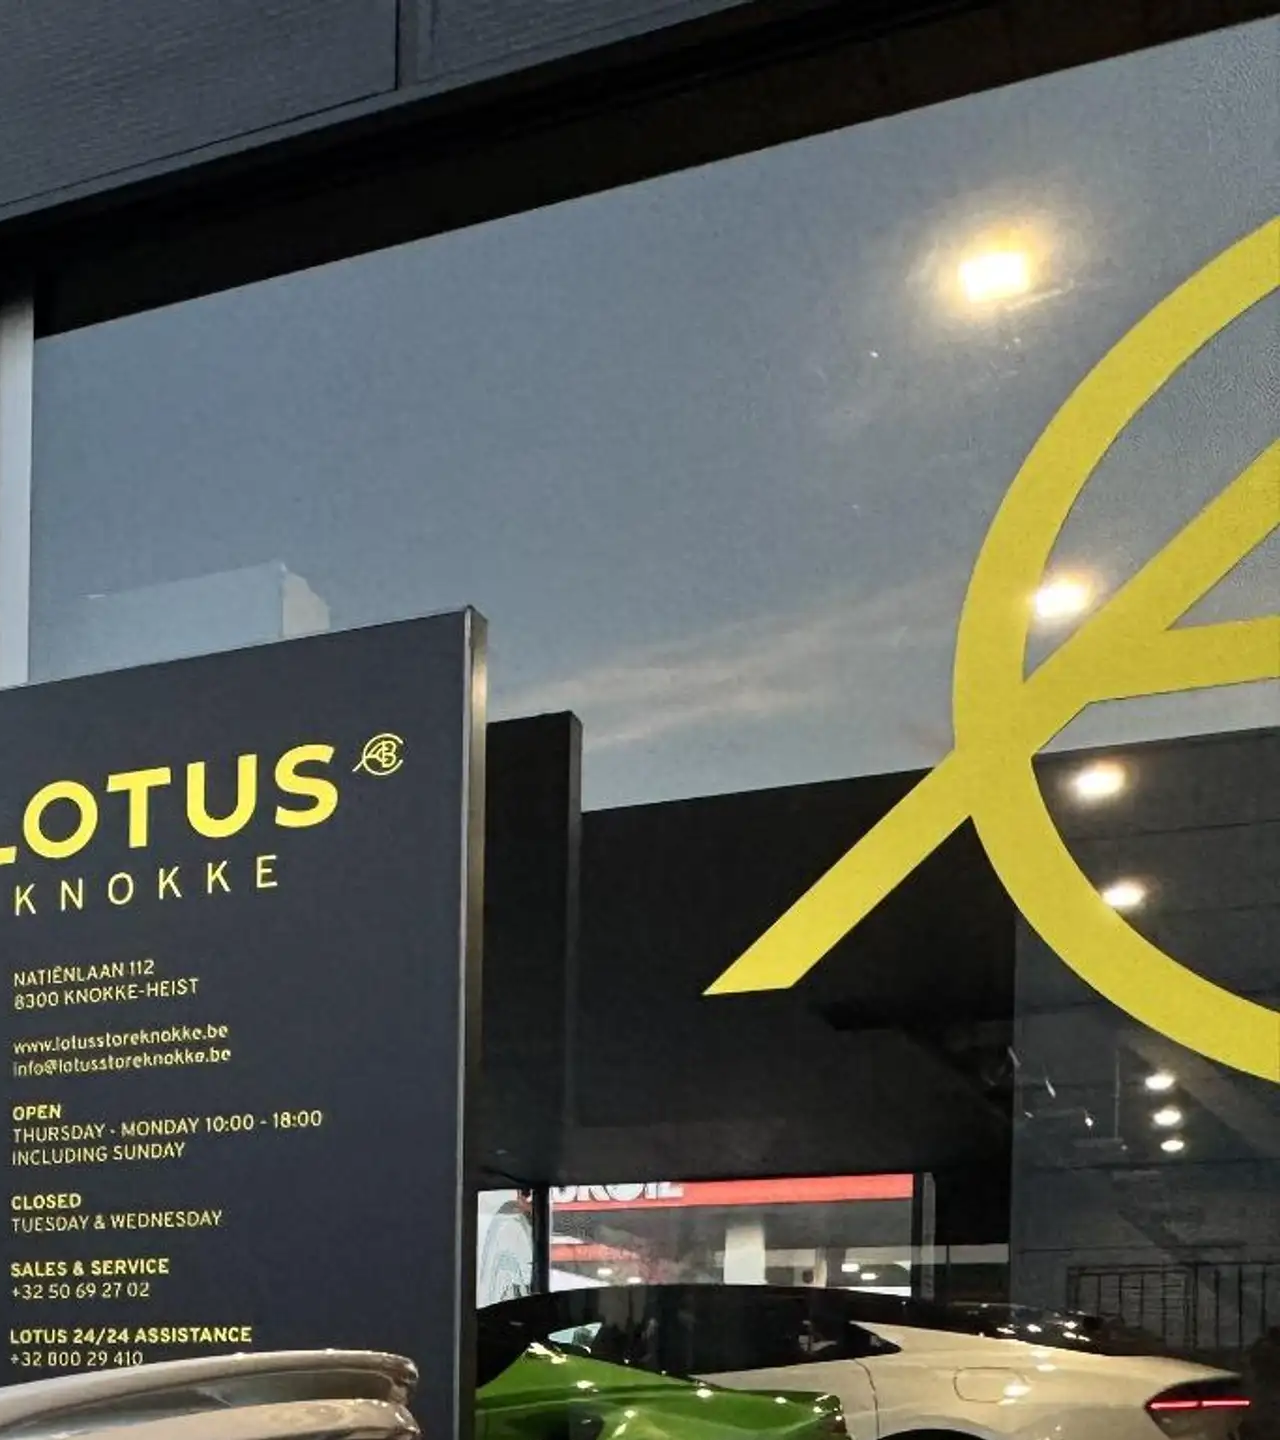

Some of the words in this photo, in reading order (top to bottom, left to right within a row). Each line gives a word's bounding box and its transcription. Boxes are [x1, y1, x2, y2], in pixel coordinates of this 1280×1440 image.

[15, 854, 278, 916] KNOKKE
[13, 961, 125, 988] NATIËNLAAN
[129, 959, 155, 976] 112
[14, 991, 59, 1010] 8300
[64, 978, 200, 1006] KNOKKE-HEIST
[13, 1023, 229, 1055] www.lotusstoreknokke.be
[13, 1048, 232, 1077] info@lotusstoreknokke.be
[12, 1104, 62, 1121] OPEN
[13, 1123, 105, 1144] THURSDAY
[121, 1117, 200, 1138] MONDAY
[205, 1114, 254, 1132] 10:00
[273, 1110, 323, 1129] 18:00
[12, 1145, 108, 1166] INCLUDING
[112, 1142, 186, 1161] SUNDAY
[11, 1193, 82, 1211] CLOSED
[11, 1216, 89, 1233] TUESDAY
[93, 1215, 106, 1230] &
[110, 1210, 223, 1230] WEDNESDAY
[10, 1261, 68, 1278] SALES
[73, 1261, 85, 1276] &
[90, 1258, 170, 1275] SERVICE
[12, 1284, 43, 1300] +32
[48, 1284, 70, 1299] 50
[75, 1283, 97, 1298] 69
[101, 1283, 122, 1298] 27
[127, 1282, 150, 1297] 02
[10, 1329, 68, 1345] LOTUS
[73, 1328, 130, 1346] 24/24
[134, 1326, 253, 1344] ASSISTANCE
[10, 1352, 42, 1367] +32
[86, 1351, 108, 1366] 29
[113, 1350, 144, 1366] 410
